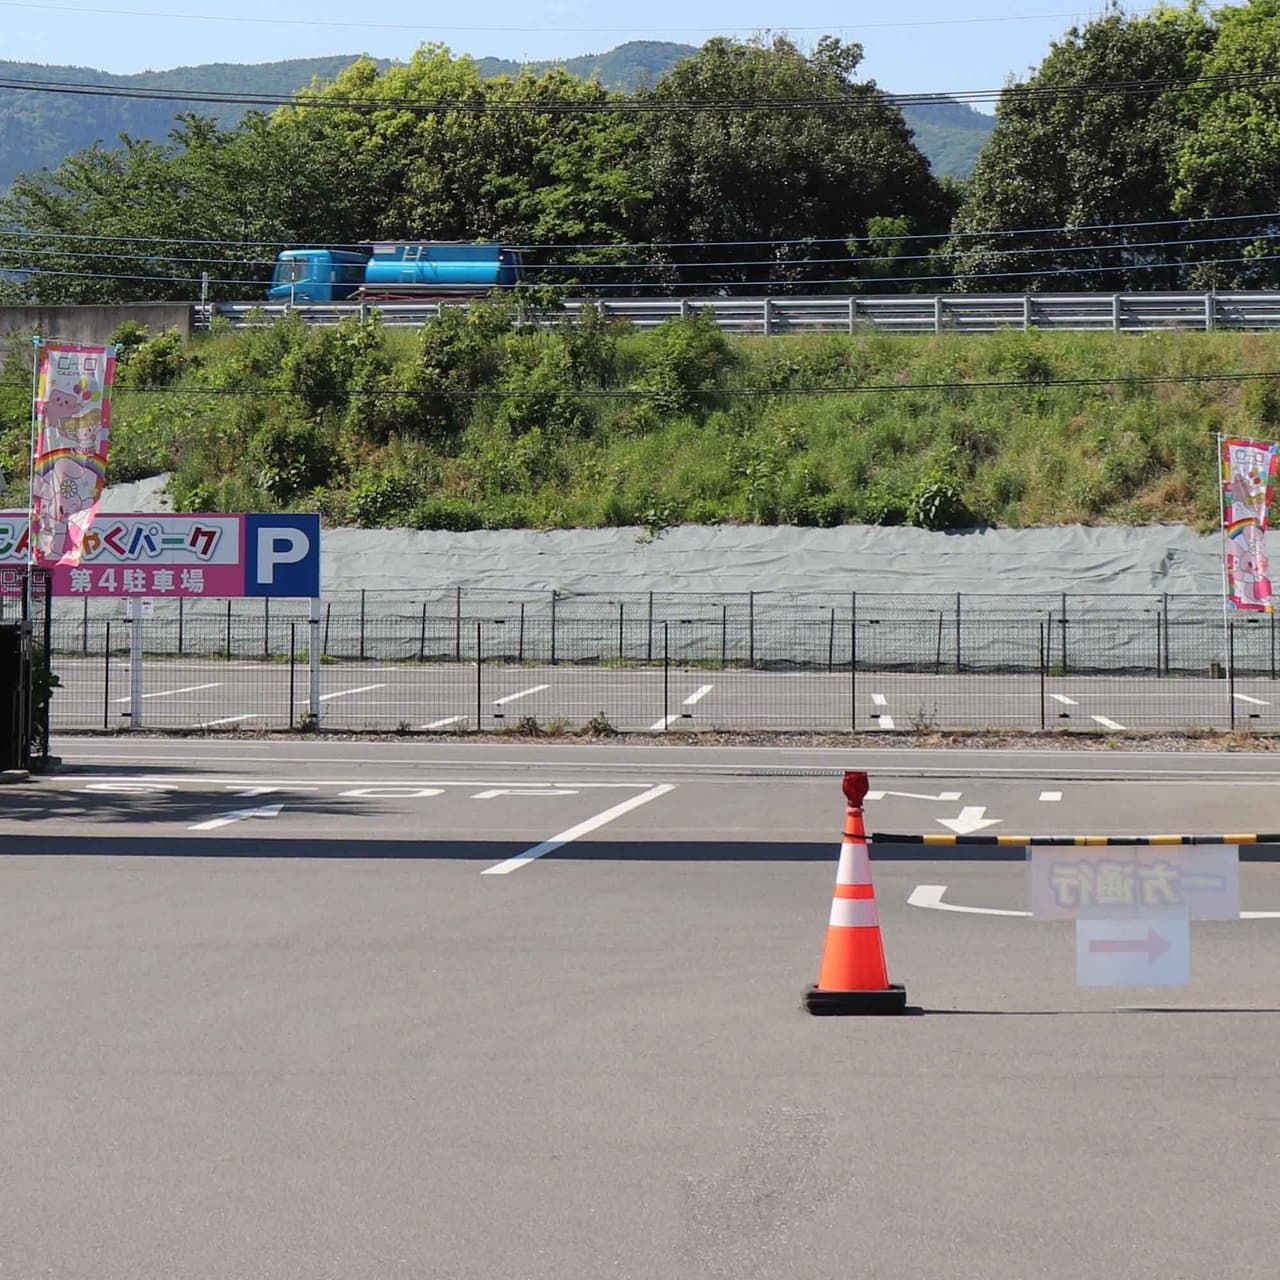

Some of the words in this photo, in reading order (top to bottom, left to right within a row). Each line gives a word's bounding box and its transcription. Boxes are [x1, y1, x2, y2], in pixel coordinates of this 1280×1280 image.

[256, 527, 310, 584] P
[70, 568, 206, 594] 第4駐車場
